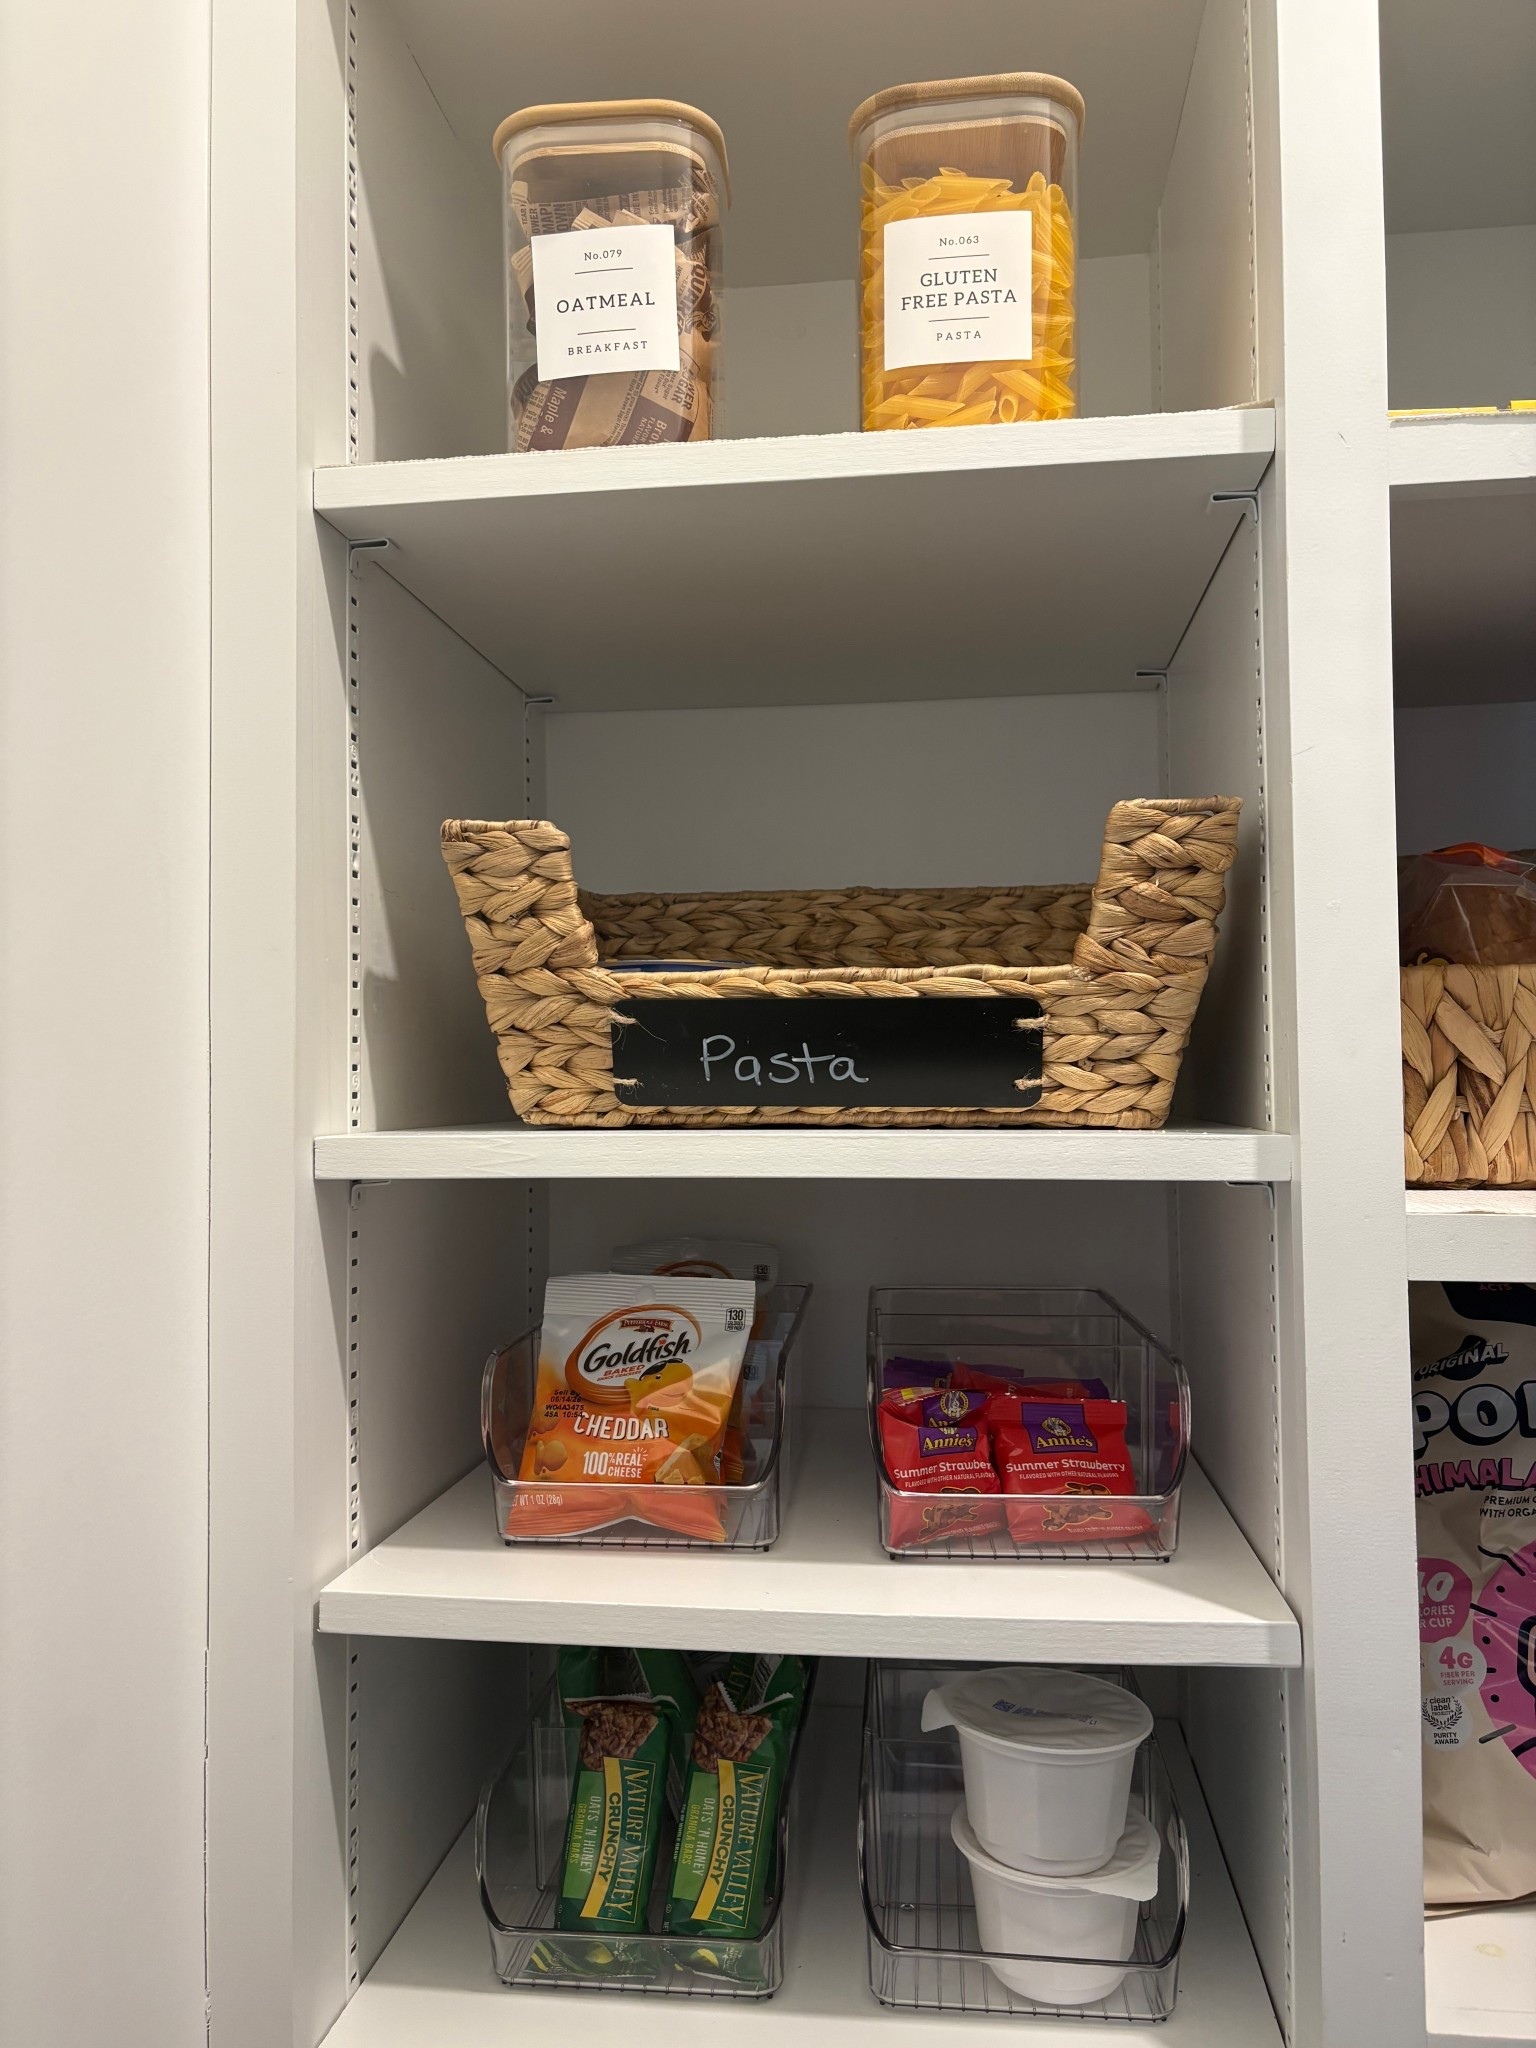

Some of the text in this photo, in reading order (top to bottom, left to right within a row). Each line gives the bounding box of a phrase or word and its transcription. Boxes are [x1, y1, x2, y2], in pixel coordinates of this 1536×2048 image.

[938, 235, 980, 247] No.063
[583, 249, 623, 261] No.079
[920, 268, 998, 288] GLUTEN
[556, 291, 656, 314] OATMEAL
[901, 289, 1018, 311] FREE PASTA
[936, 330, 982, 341] PASTA
[567, 340, 649, 356] BREAKFAST
[539, 386, 568, 435] Maple &
[700, 1034, 869, 1086] Pasta
[728, 1309, 744, 1321] 130
[583, 1331, 689, 1373] Goldfish
[1418, 1342, 1509, 1376] ORIGINAL
[603, 1364, 645, 1377] BAKED
[573, 1411, 669, 1441] CHEDDAR
[922, 1433, 974, 1452] Annie's
[1036, 1434, 1094, 1449] Annie's
[615, 1452, 643, 1467] REAL
[1005, 1459, 1126, 1473] Summer Strawberry
[607, 1466, 643, 1479] CHEESE
[893, 1464, 938, 1479] Summer
[519, 1494, 529, 1506] WT
[535, 1494, 546, 1505] OZ
[1483, 1495, 1530, 1506] PREMIUM
[1479, 1507, 1506, 1518] WITH
[1420, 1604, 1456, 1618] ORIES
[1429, 1617, 1453, 1629] CUP
[1438, 1645, 1473, 1670] 4G
[1440, 1670, 1475, 1679] FIBER PER
[1442, 1677, 1474, 1687] SERVING
[1429, 1696, 1451, 1705] clean
[1430, 1702, 1451, 1712] label
[587, 1795, 602, 1822] OATS
[623, 1765, 650, 1842] NATURE
[737, 1769, 766, 1845] NATURE
[571, 1803, 587, 1840] GRANOLA
[598, 1792, 621, 1883] CRUNCHY
[681, 1804, 701, 1865] GRANOLA BARS
[691, 1797, 716, 1877] OATS 'N HONEY
[710, 1794, 735, 1886] CRUNCHY
[569, 1842, 581, 1864] BARS
[579, 1839, 595, 1875] HONEY
[604, 1845, 642, 1916] VALLEY
[715, 1848, 753, 1921] VALLEY
